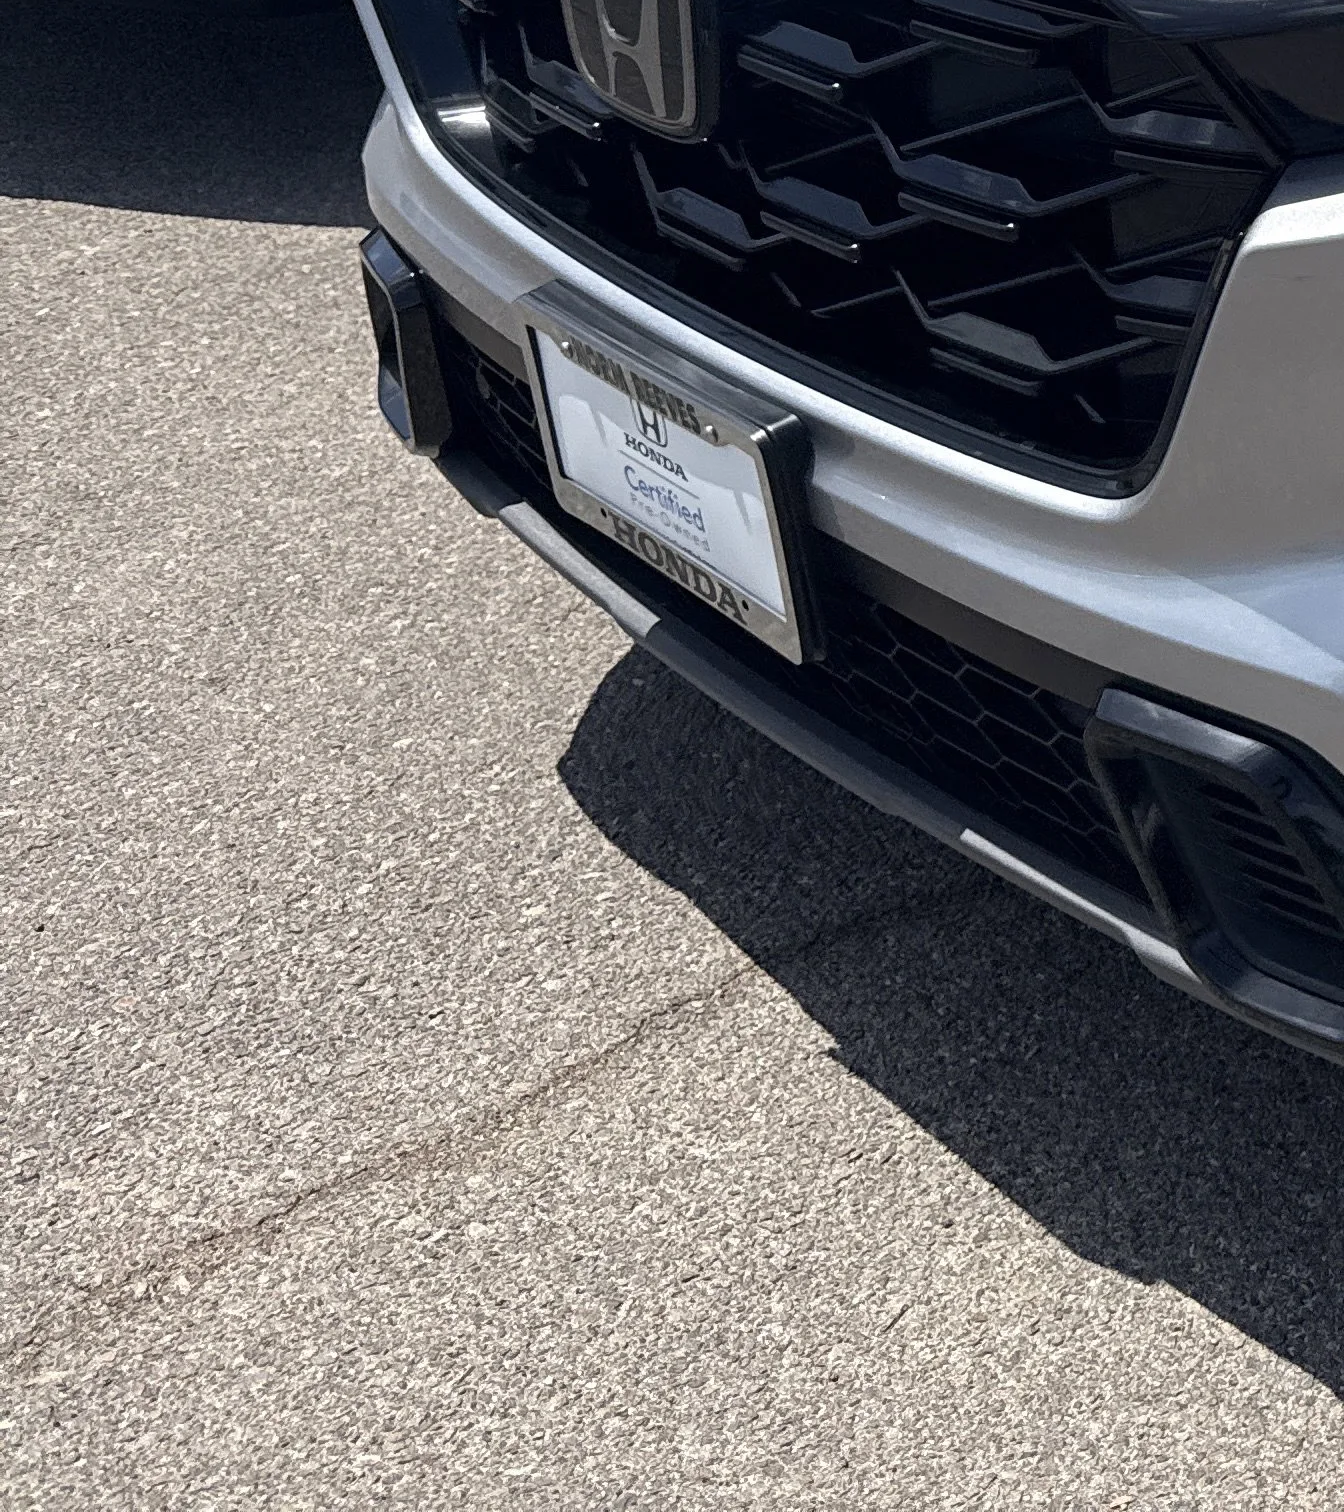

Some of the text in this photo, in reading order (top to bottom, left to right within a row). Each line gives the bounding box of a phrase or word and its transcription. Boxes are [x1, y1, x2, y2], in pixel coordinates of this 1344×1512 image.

[623, 432, 689, 483] HONDA
[623, 464, 706, 533] Certified
[606, 514, 748, 626] HONDA
